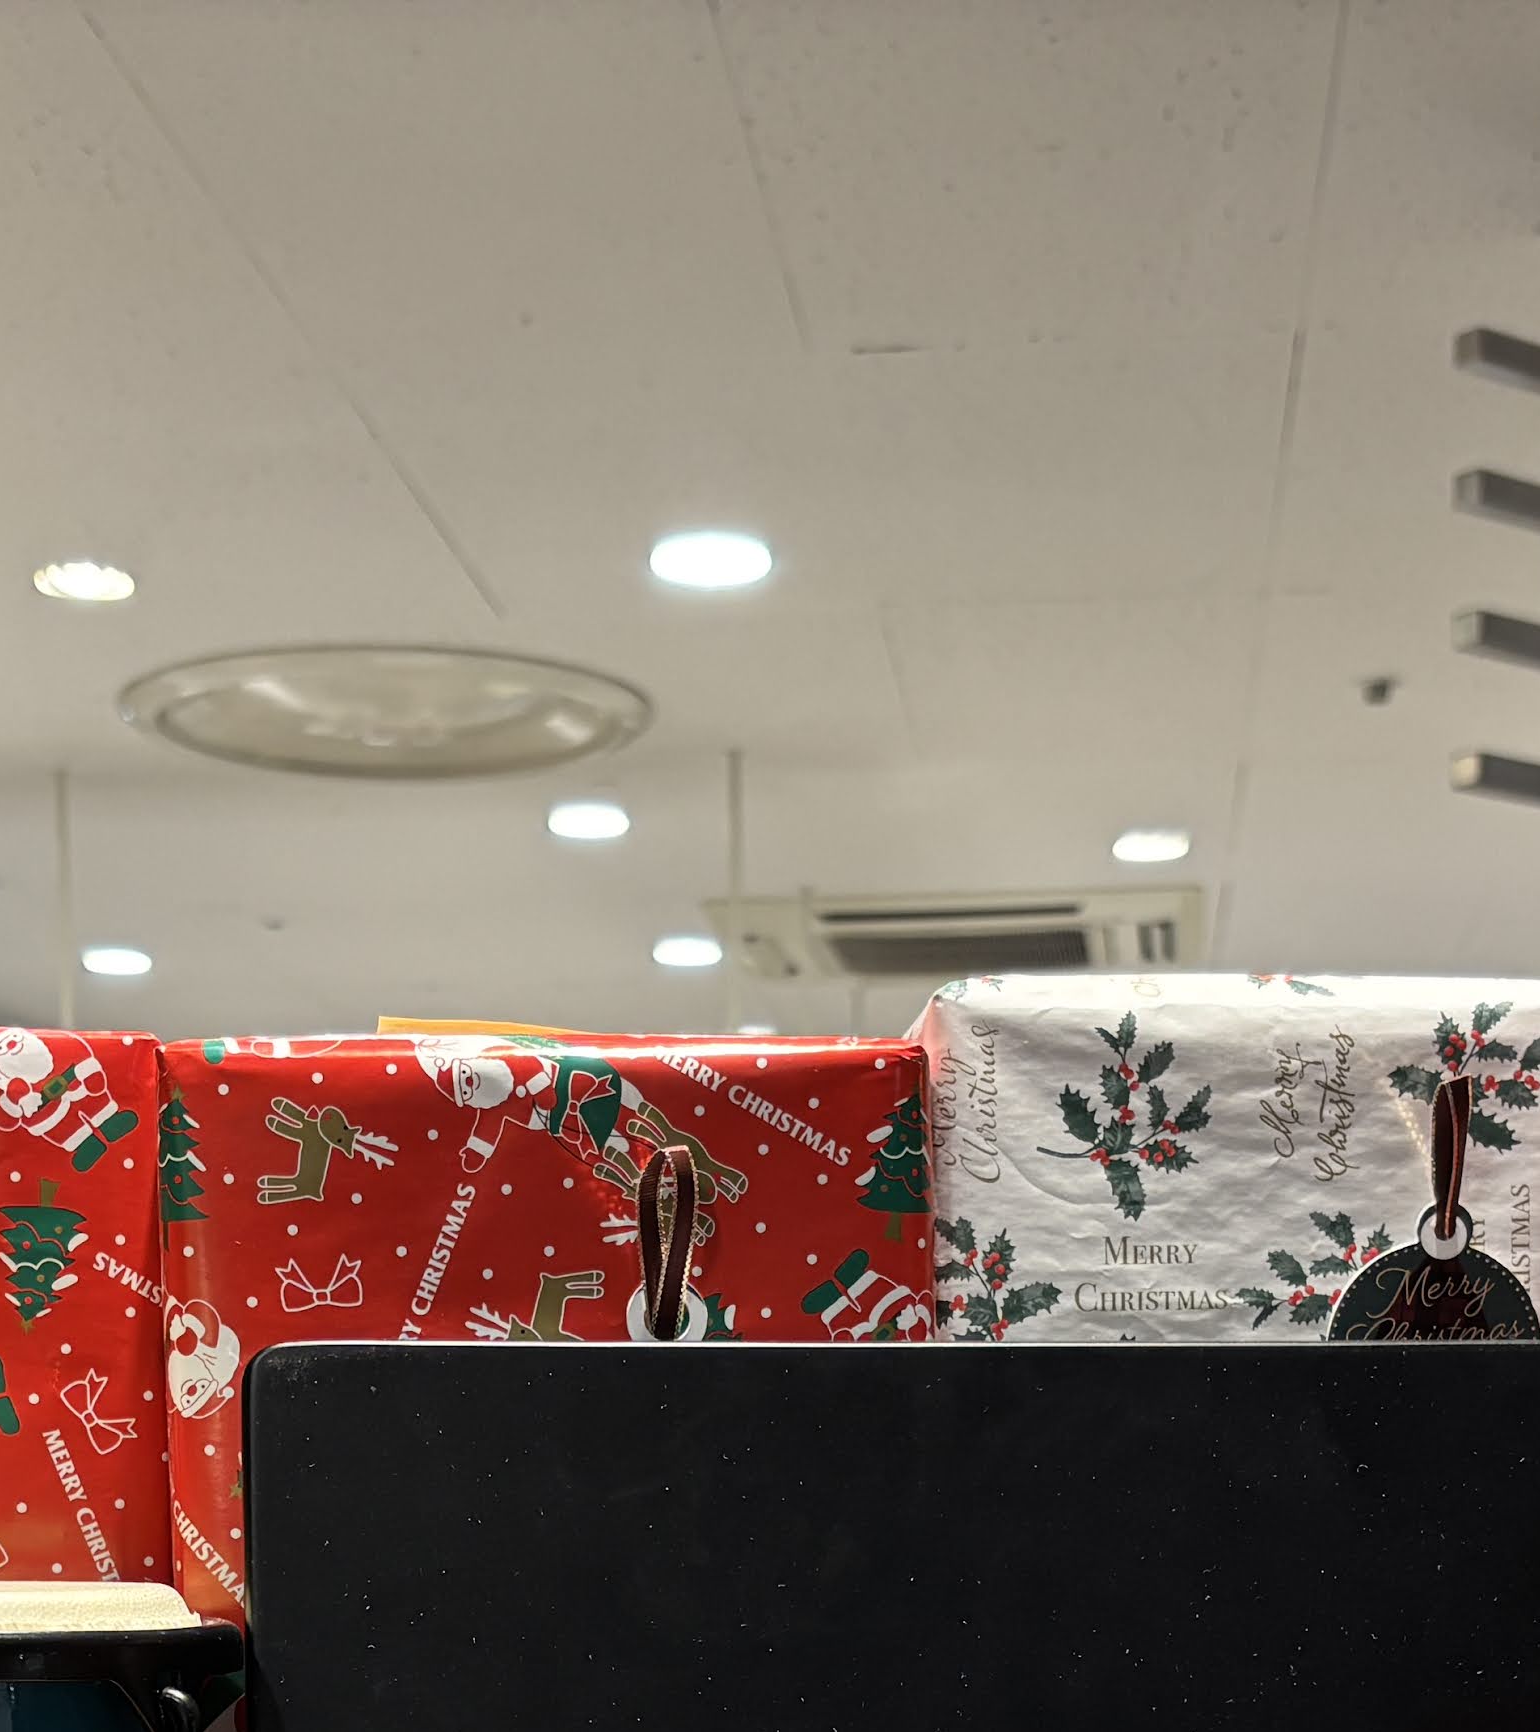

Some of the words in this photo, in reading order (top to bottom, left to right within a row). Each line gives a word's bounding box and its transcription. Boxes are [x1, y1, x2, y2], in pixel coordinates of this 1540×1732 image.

[727, 1084, 853, 1168] CHRISTMAS
[1258, 1043, 1303, 1159] Merry
[1312, 1025, 1358, 1183] Christmas
[411, 1183, 477, 1317] CHRISTMAS
[1346, 1315, 1525, 1341] Christmas
[1375, 1267, 1496, 1323] Merry
[42, 1429, 87, 1503] MERRY
